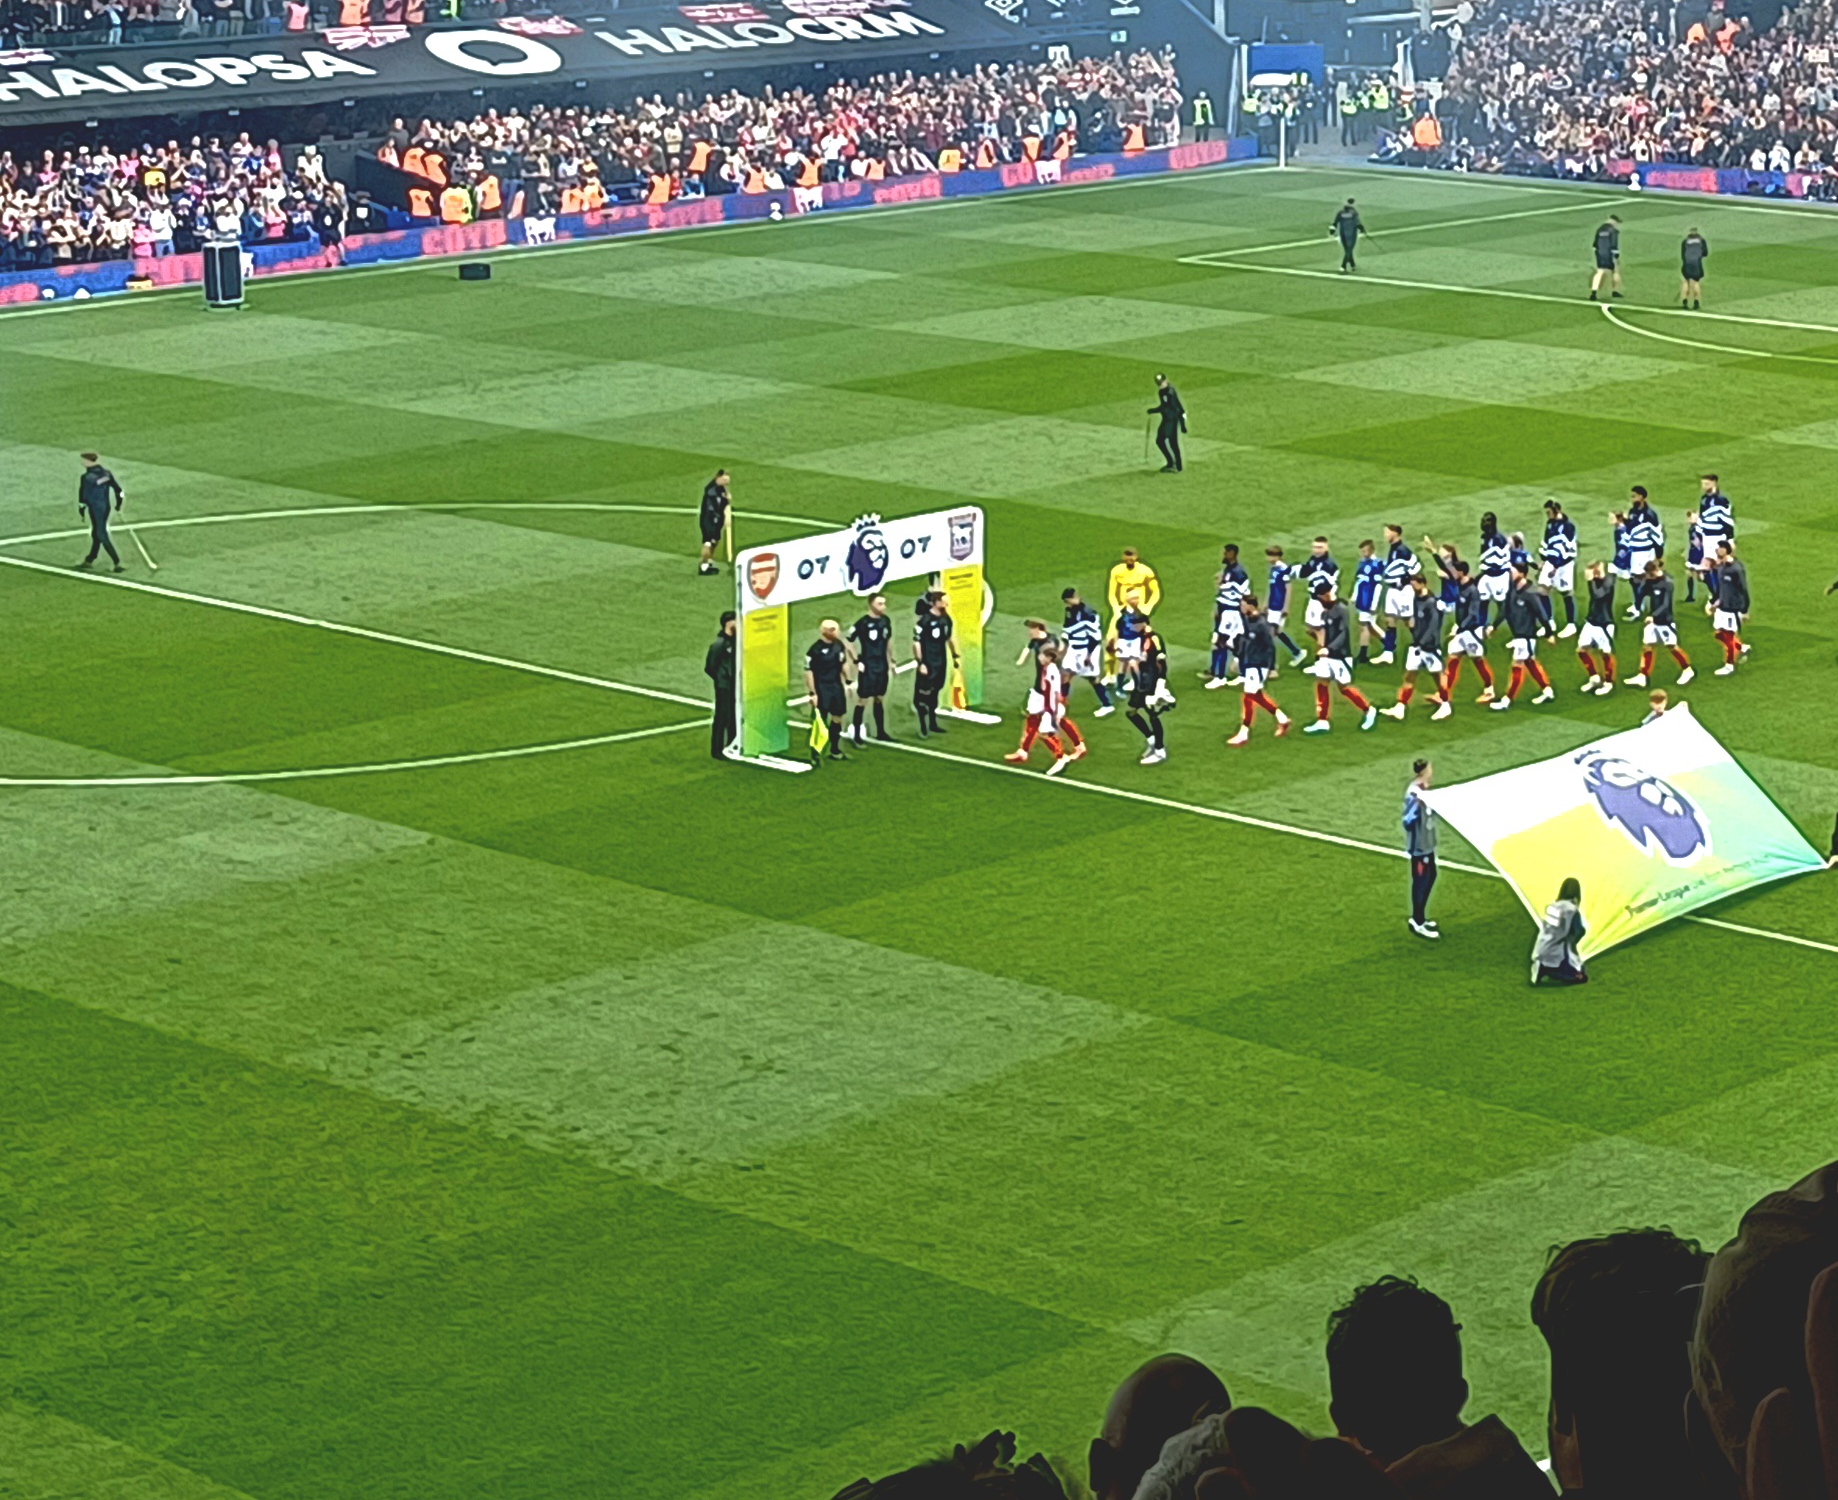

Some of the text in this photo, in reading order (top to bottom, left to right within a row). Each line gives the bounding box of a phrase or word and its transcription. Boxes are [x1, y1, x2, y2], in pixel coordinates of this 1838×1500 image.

[594, 11, 945, 56] HALOCRM
[0, 50, 378, 101] HALOPSA
[797, 535, 932, 581] 07 07
